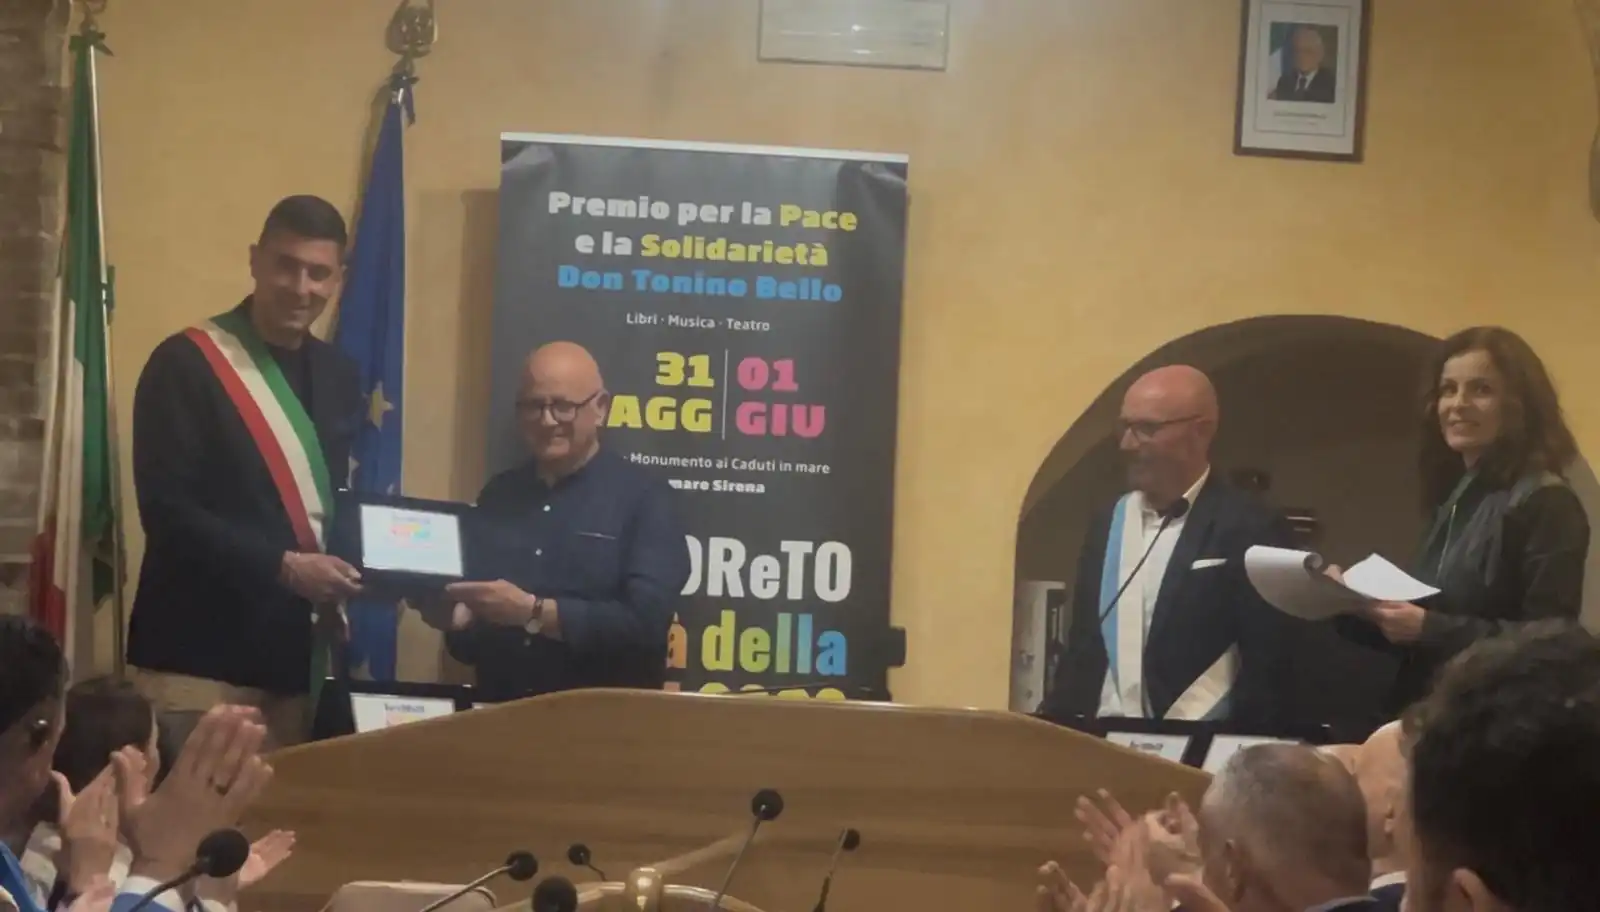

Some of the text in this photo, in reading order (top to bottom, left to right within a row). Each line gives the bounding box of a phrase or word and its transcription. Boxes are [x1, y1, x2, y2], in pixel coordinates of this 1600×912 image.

[548, 191, 858, 232] Premio per la Pace
[575, 231, 828, 266] e la Solidarietà
[558, 265, 842, 303] Don Tonino Bello
[626, 312, 770, 331] Libri Musica Teatro
[655, 351, 715, 388] 31
[737, 356, 799, 391] 01
[735, 401, 825, 438] GIU
[630, 452, 831, 475] Monumento ai Caduti in mare
[712, 479, 765, 493] Sirena
[702, 610, 847, 676] della
